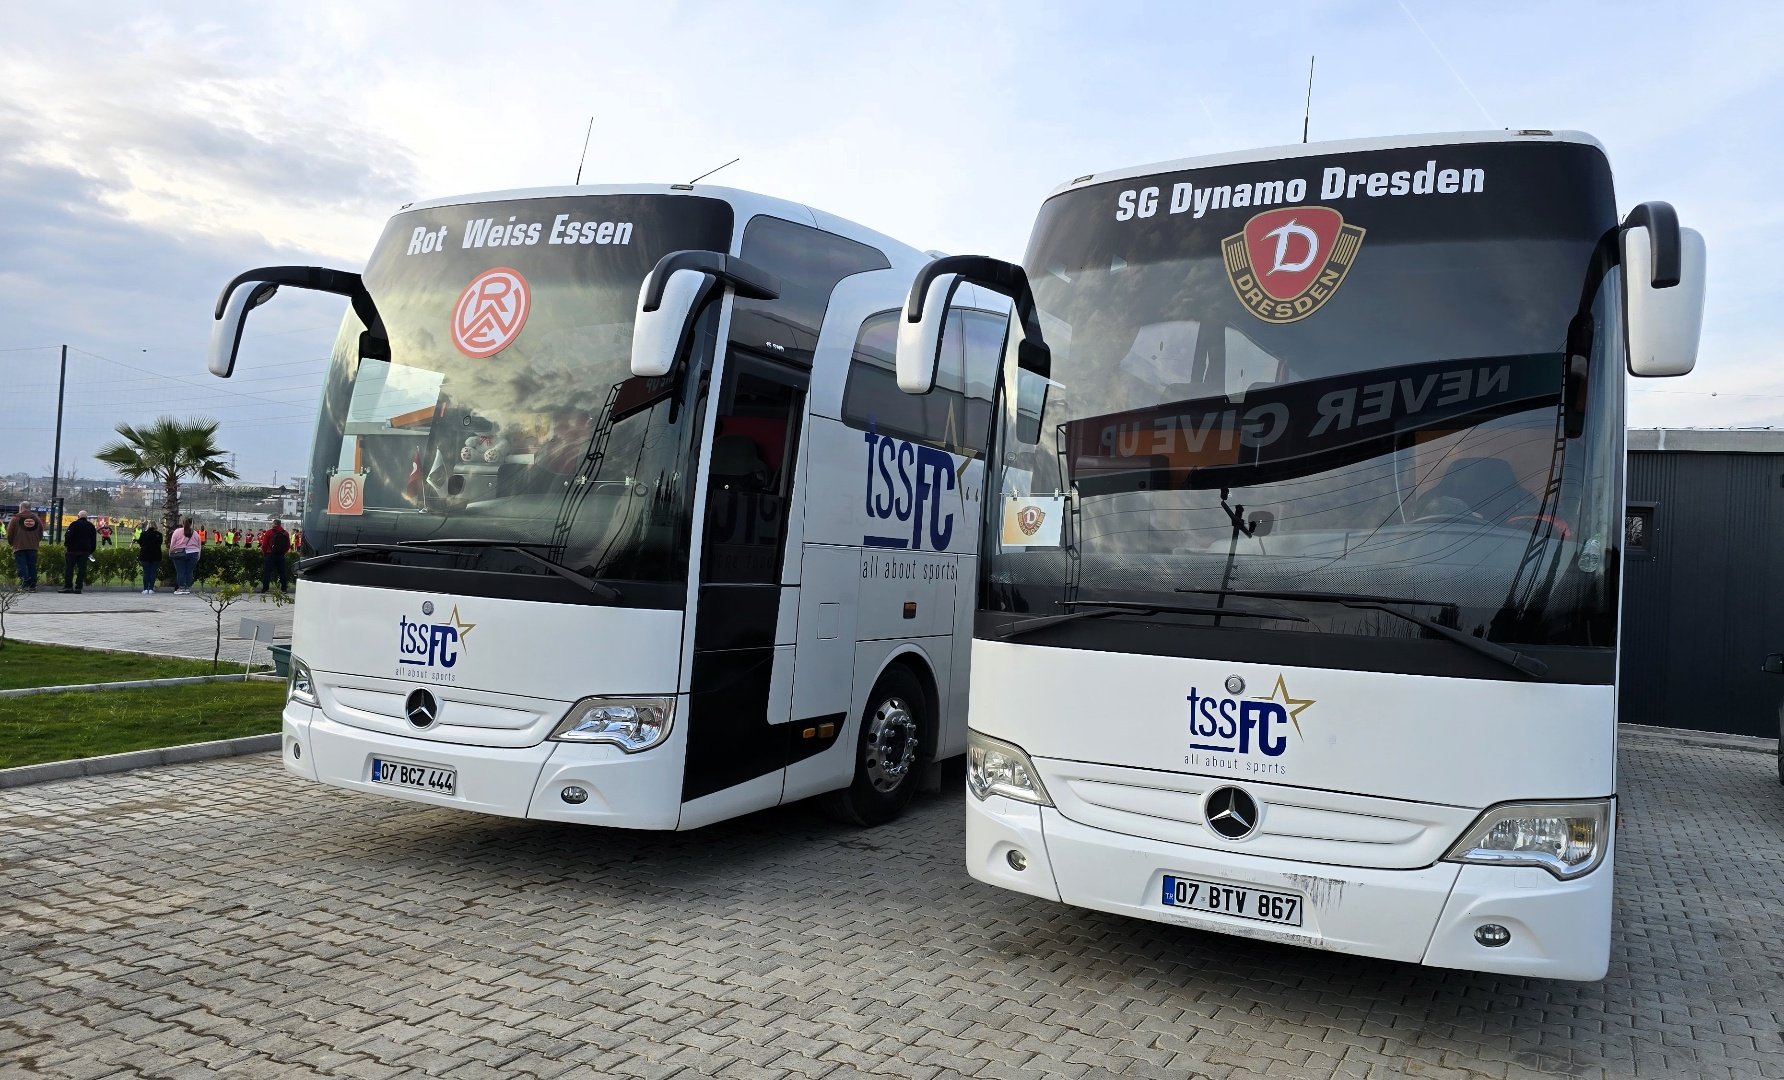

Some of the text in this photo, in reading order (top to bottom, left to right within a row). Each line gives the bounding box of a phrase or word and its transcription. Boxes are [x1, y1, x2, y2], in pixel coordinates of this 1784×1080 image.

[1116, 160, 1485, 222] SG Dynamo Dresden
[406, 213, 634, 256] Rot Weiss Essen
[1237, 268, 1341, 318] DRESDEN
[864, 413, 956, 551] tssFC
[862, 555, 956, 584] all about sports
[399, 614, 458, 668] tssFC
[395, 667, 405, 676] all
[408, 669, 428, 679] about
[1186, 686, 1288, 757] tssFC
[381, 763, 453, 791] 07 BCZ 444
[1184, 753, 1287, 775] all about sports
[1175, 881, 1297, 921] 07 BTV 867
